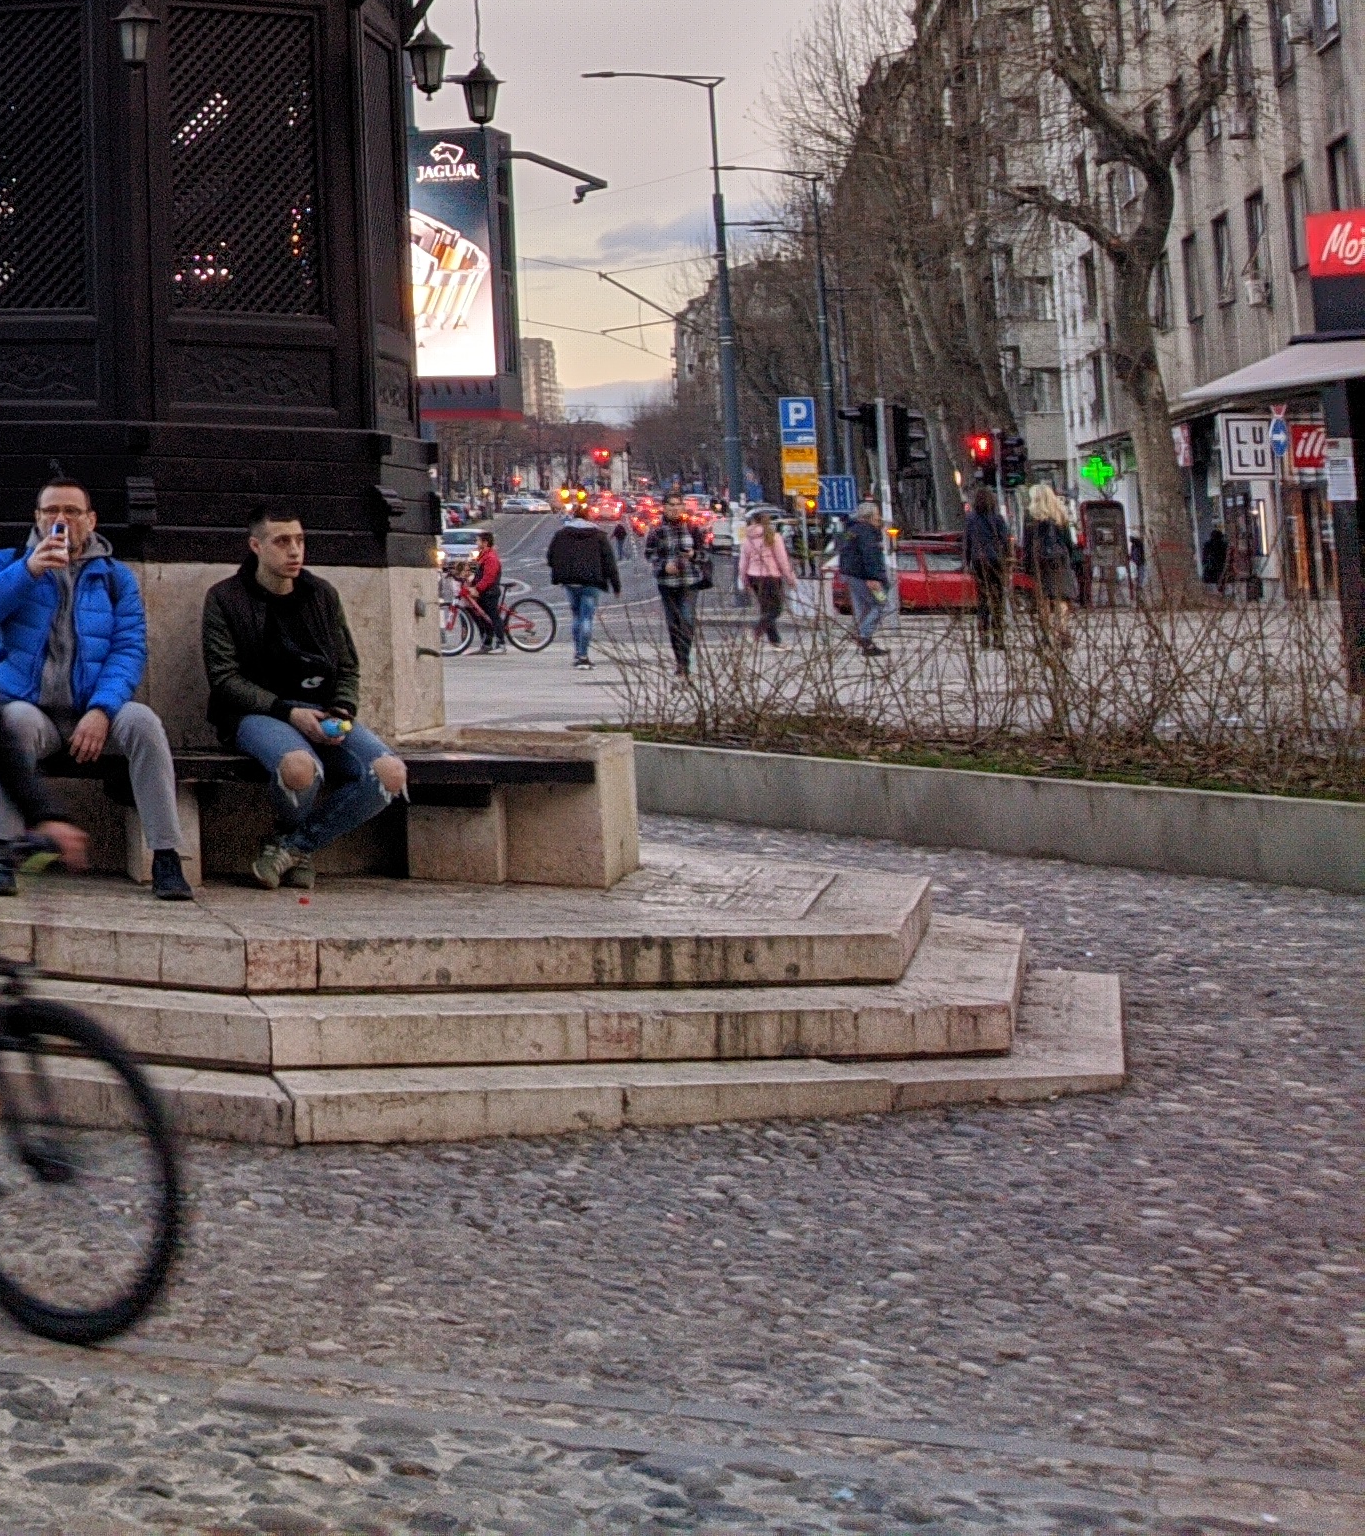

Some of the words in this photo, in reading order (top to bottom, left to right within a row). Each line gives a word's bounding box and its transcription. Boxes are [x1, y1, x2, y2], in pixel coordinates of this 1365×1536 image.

[416, 163, 480, 183] JAGUAR
[789, 402, 807, 426] P
[1235, 426, 1264, 445] LU
[1237, 449, 1266, 468] LU
